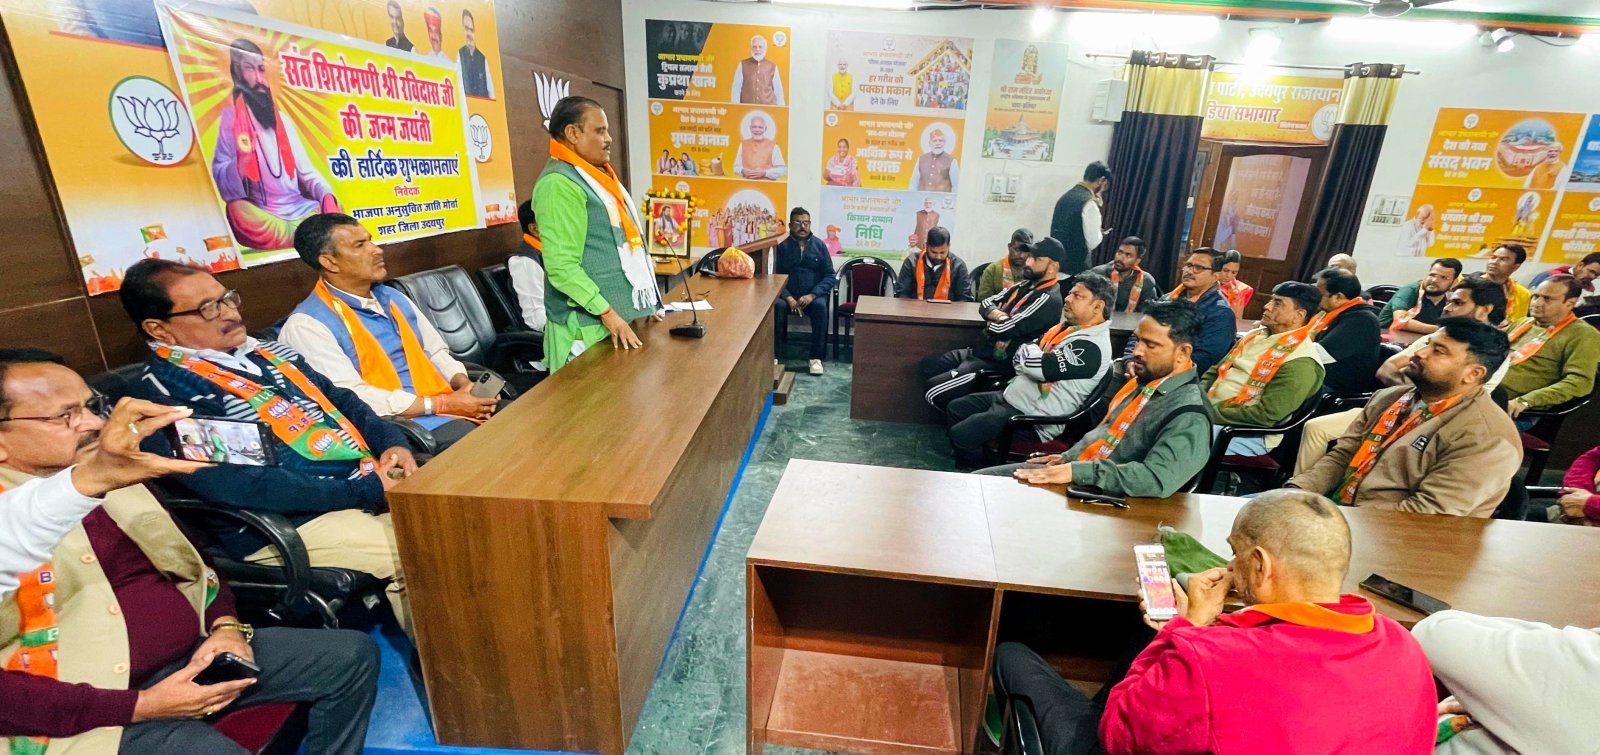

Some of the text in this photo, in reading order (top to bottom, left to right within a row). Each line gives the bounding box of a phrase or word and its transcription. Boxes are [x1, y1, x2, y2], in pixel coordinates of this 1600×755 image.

[399, 70, 440, 105] रविदास
[440, 78, 455, 107] जी
[859, 84, 912, 96] पक्का मकान
[340, 104, 432, 142] की जन्म जयंती
[329, 148, 354, 178] की
[1428, 152, 1494, 171] संसद भवन
[352, 207, 384, 219] भाजपा
[423, 199, 441, 212] जाति
[847, 212, 870, 223] किसान
[397, 220, 419, 233] जिला
[855, 224, 884, 240] निधि
